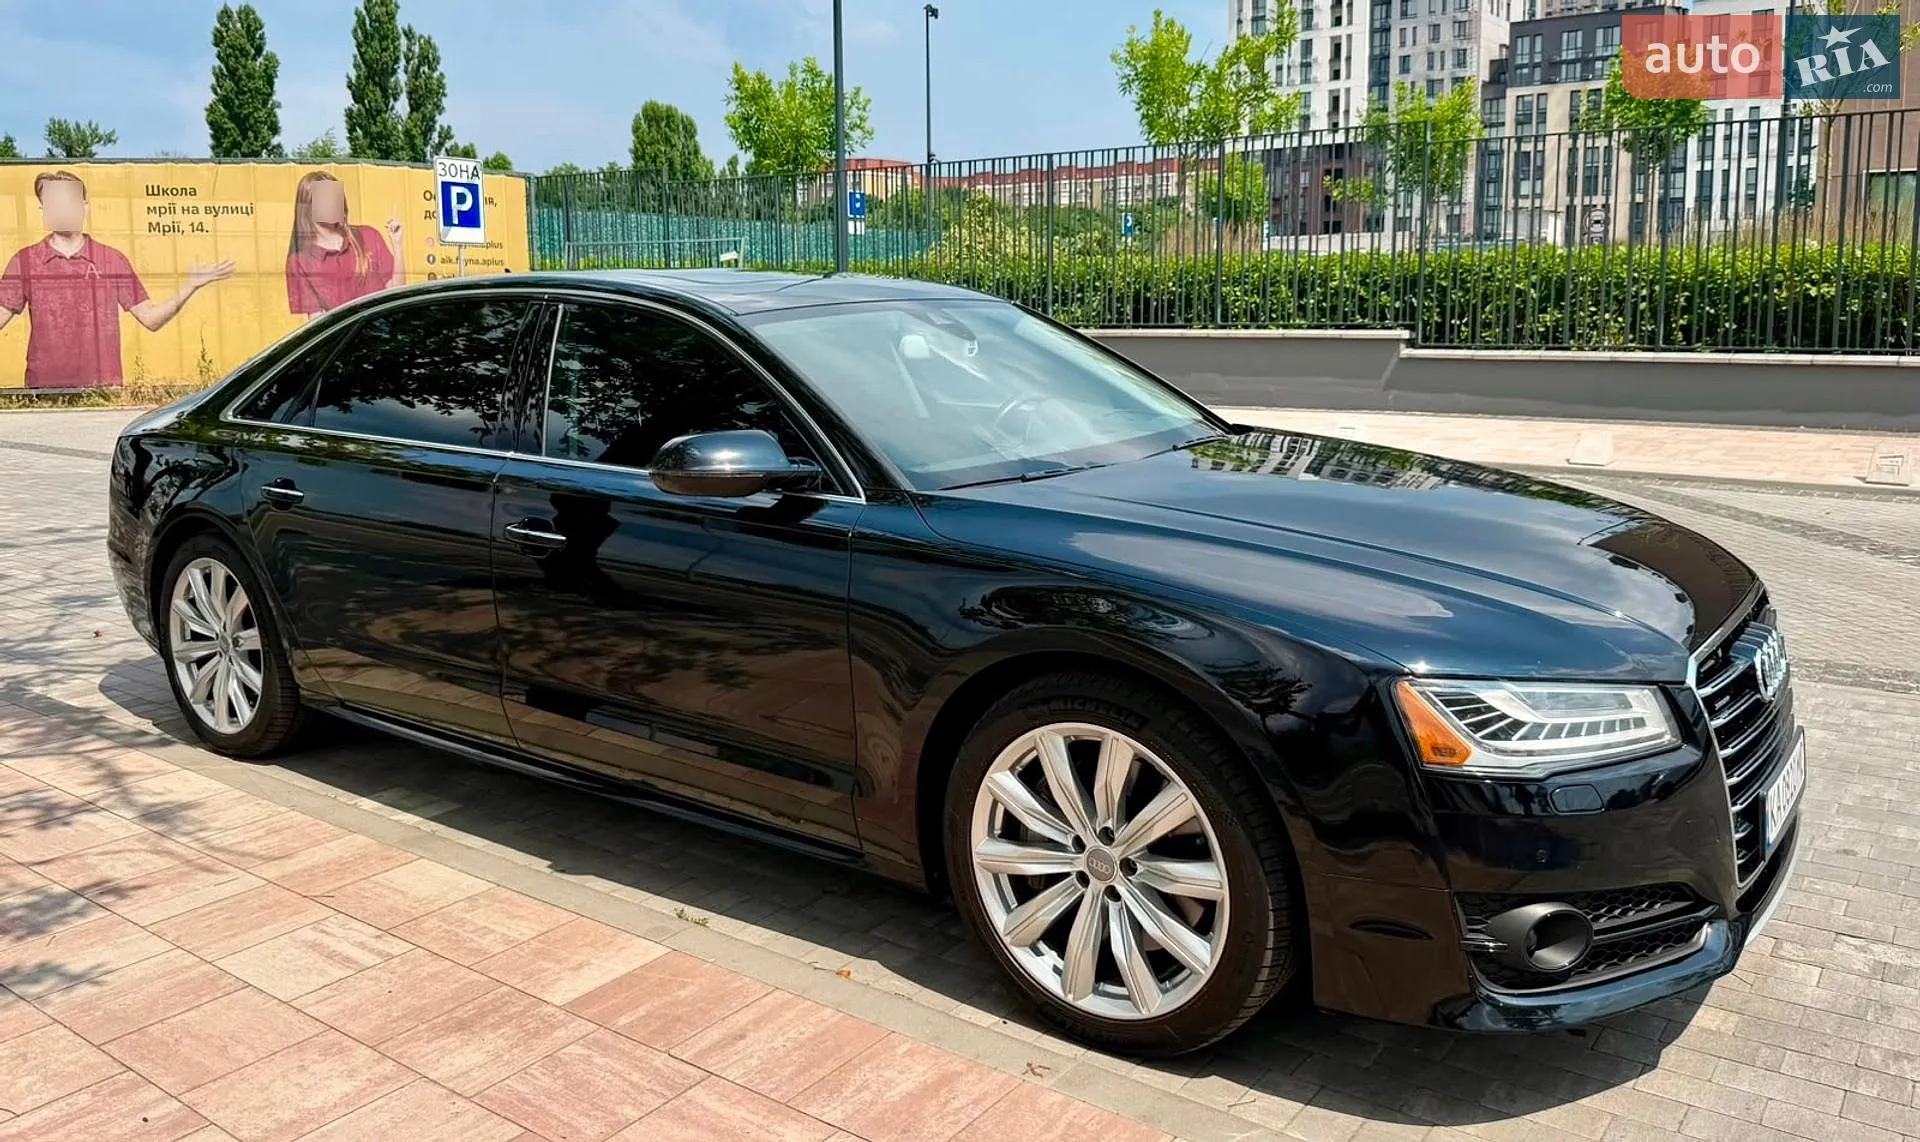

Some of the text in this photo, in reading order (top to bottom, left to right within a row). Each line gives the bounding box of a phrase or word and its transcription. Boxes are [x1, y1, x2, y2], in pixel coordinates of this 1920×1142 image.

[438, 162, 480, 179] ЗОНА
[145, 184, 197, 197] Школа
[146, 202, 254, 218] мрії на вулиці
[450, 185, 474, 225] P
[148, 220, 210, 236] Мрії, 14.
